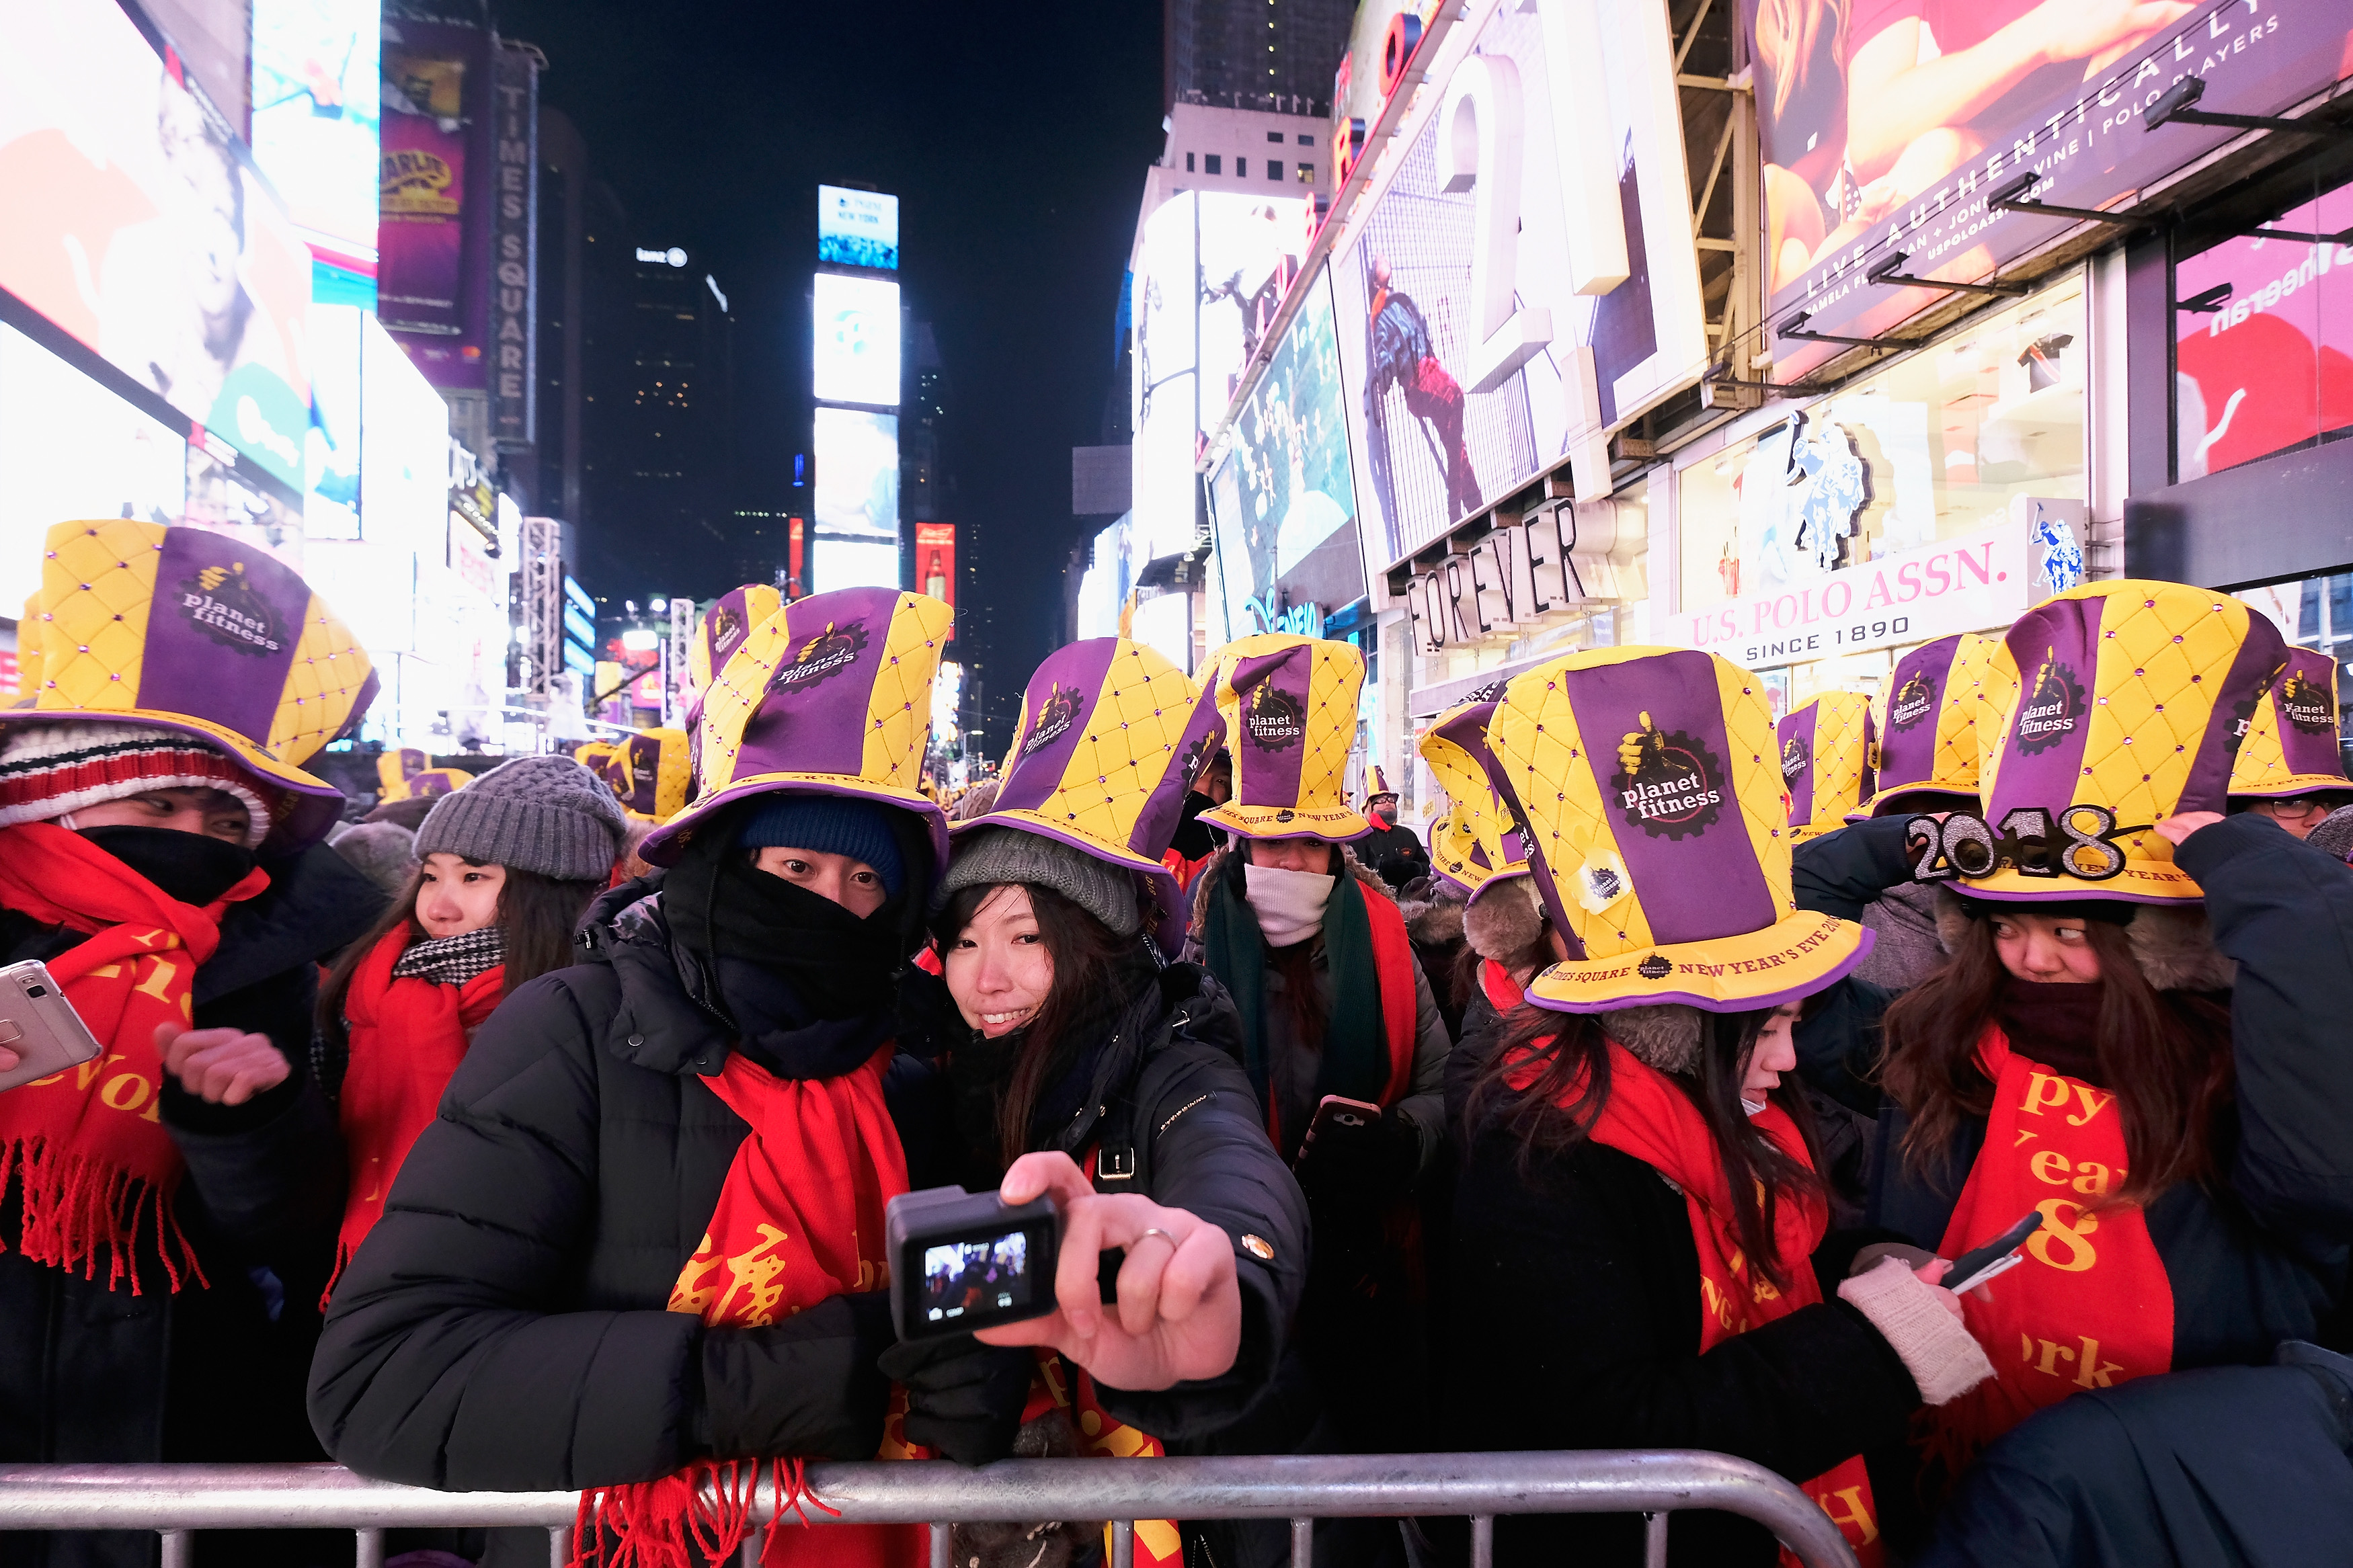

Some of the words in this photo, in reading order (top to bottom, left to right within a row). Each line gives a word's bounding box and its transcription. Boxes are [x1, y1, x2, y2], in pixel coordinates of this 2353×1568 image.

[499, 83, 526, 219] TIMES
[1804, 284, 1850, 316] PAMELA
[2102, 89, 2161, 134] POLO
[1807, 243, 1866, 298] LIVE
[497, 233, 527, 398] SQUARE
[1405, 497, 1587, 657] FOREVER
[1692, 608, 1744, 647] U.S.
[1752, 580, 1853, 636] POLO
[1862, 541, 2007, 611] ASSN.
[183, 593, 266, 634] planet
[192, 607, 279, 651] fitness
[1747, 634, 1821, 661] SINCE
[1835, 616, 1909, 645] 1890
[777, 647, 846, 682] planet
[783, 652, 854, 686] fitness
[1249, 714, 1291, 729] planet
[1892, 696, 1925, 719] planet
[1894, 703, 1931, 724] fitness
[2019, 700, 2063, 727] planet
[1023, 712, 1066, 752] planet
[1025, 720, 1071, 755] fitness
[1254, 725, 1300, 737] fitness
[2020, 717, 2073, 737] fitness
[1781, 753, 1800, 773] planet
[1785, 760, 1807, 777] fitness
[1621, 772, 1701, 809] planet
[1638, 789, 1720, 819] fitness
[1238, 815, 1273, 825] SQUARE
[1323, 811, 1353, 821] YEAR'S
[1905, 805, 2126, 885] 2018
[1462, 870, 1482, 882] NEW
[1550, 971, 1574, 981] TIMES
[1575, 966, 1632, 983] SQUARE
[1679, 963, 1725, 977] NEW
[1728, 948, 1800, 975] YEAR'S
[1796, 930, 1829, 954] EVE
